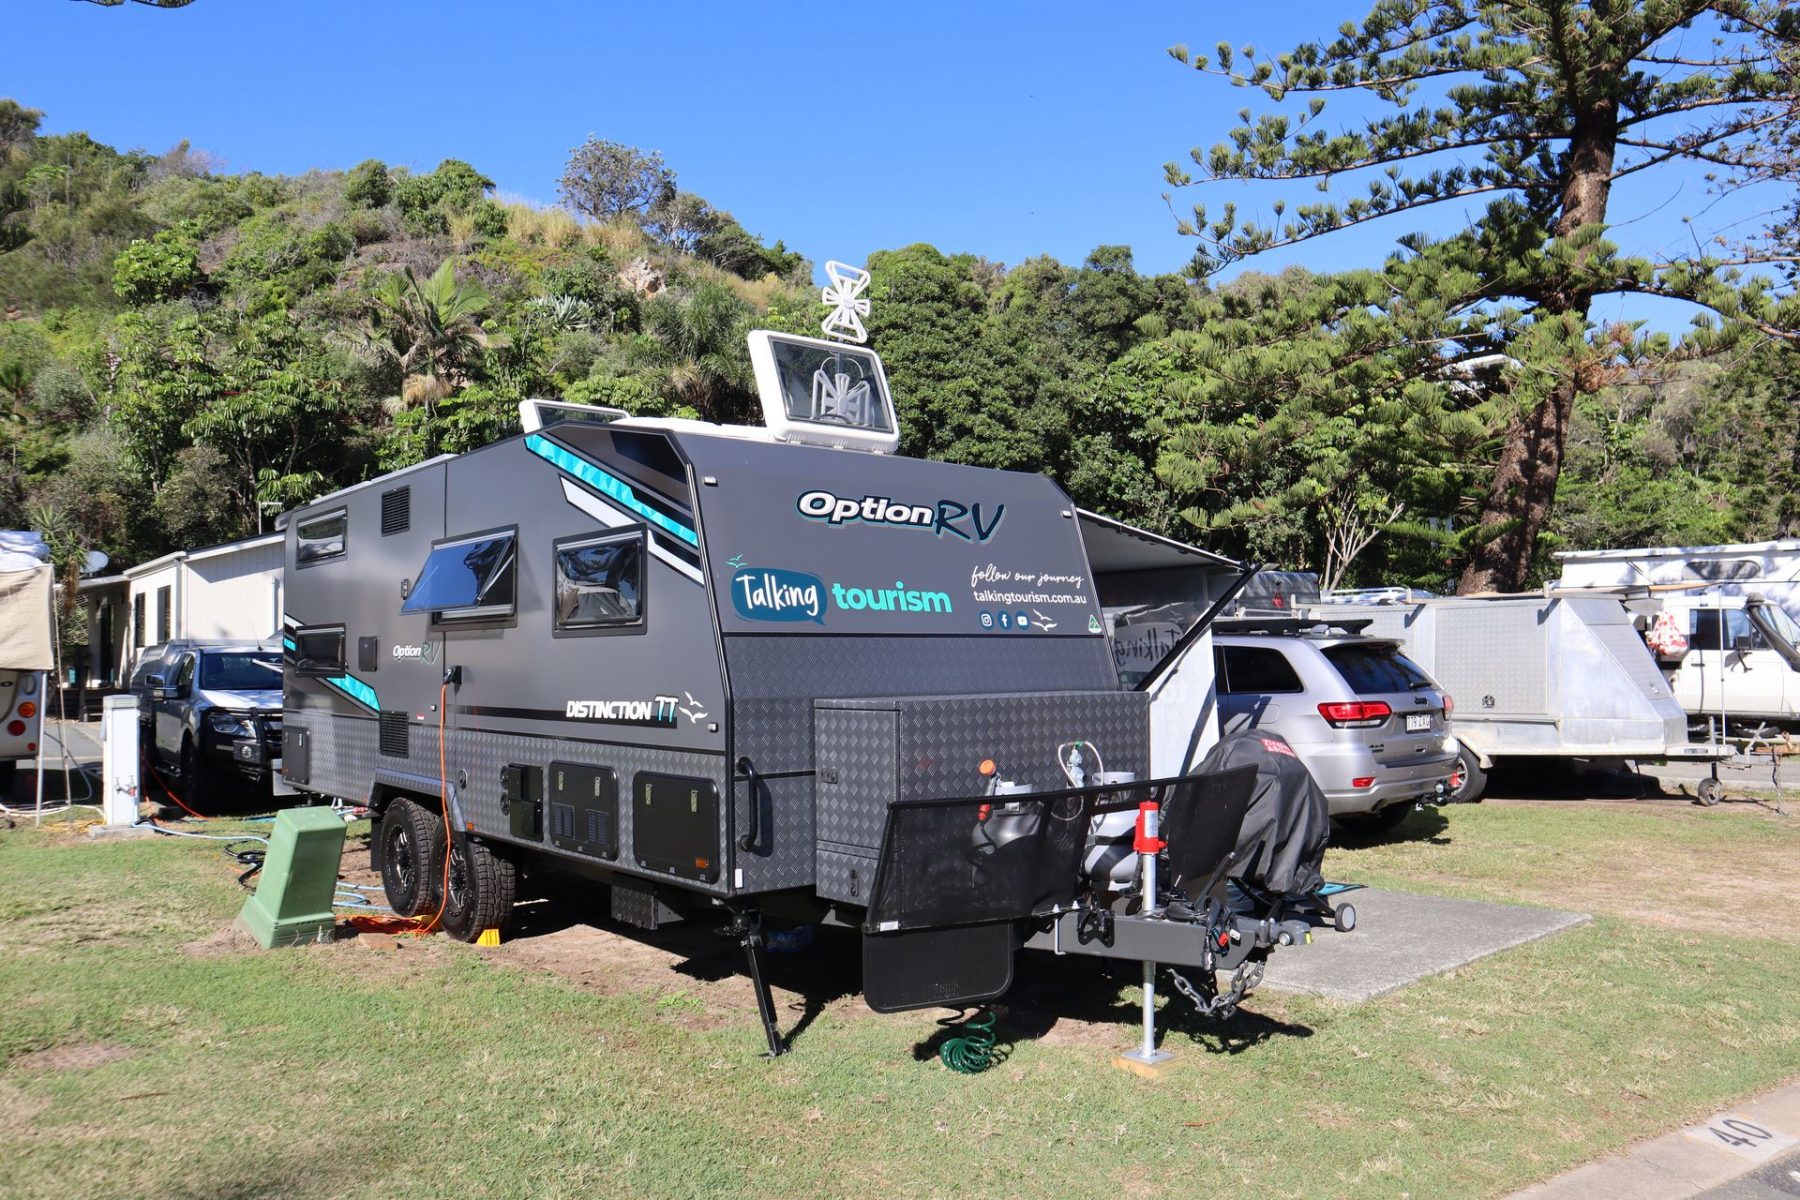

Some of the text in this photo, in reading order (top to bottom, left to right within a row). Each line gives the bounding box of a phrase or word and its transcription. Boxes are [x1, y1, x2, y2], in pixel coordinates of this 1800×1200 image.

[971, 563, 1085, 589] follow our journey
[735, 573, 953, 616] Talking tourism
[973, 590, 1088, 605] talkingtourism.com.au
[566, 700, 652, 721] DISTINCTION
[1708, 1119, 1774, 1148] 40
